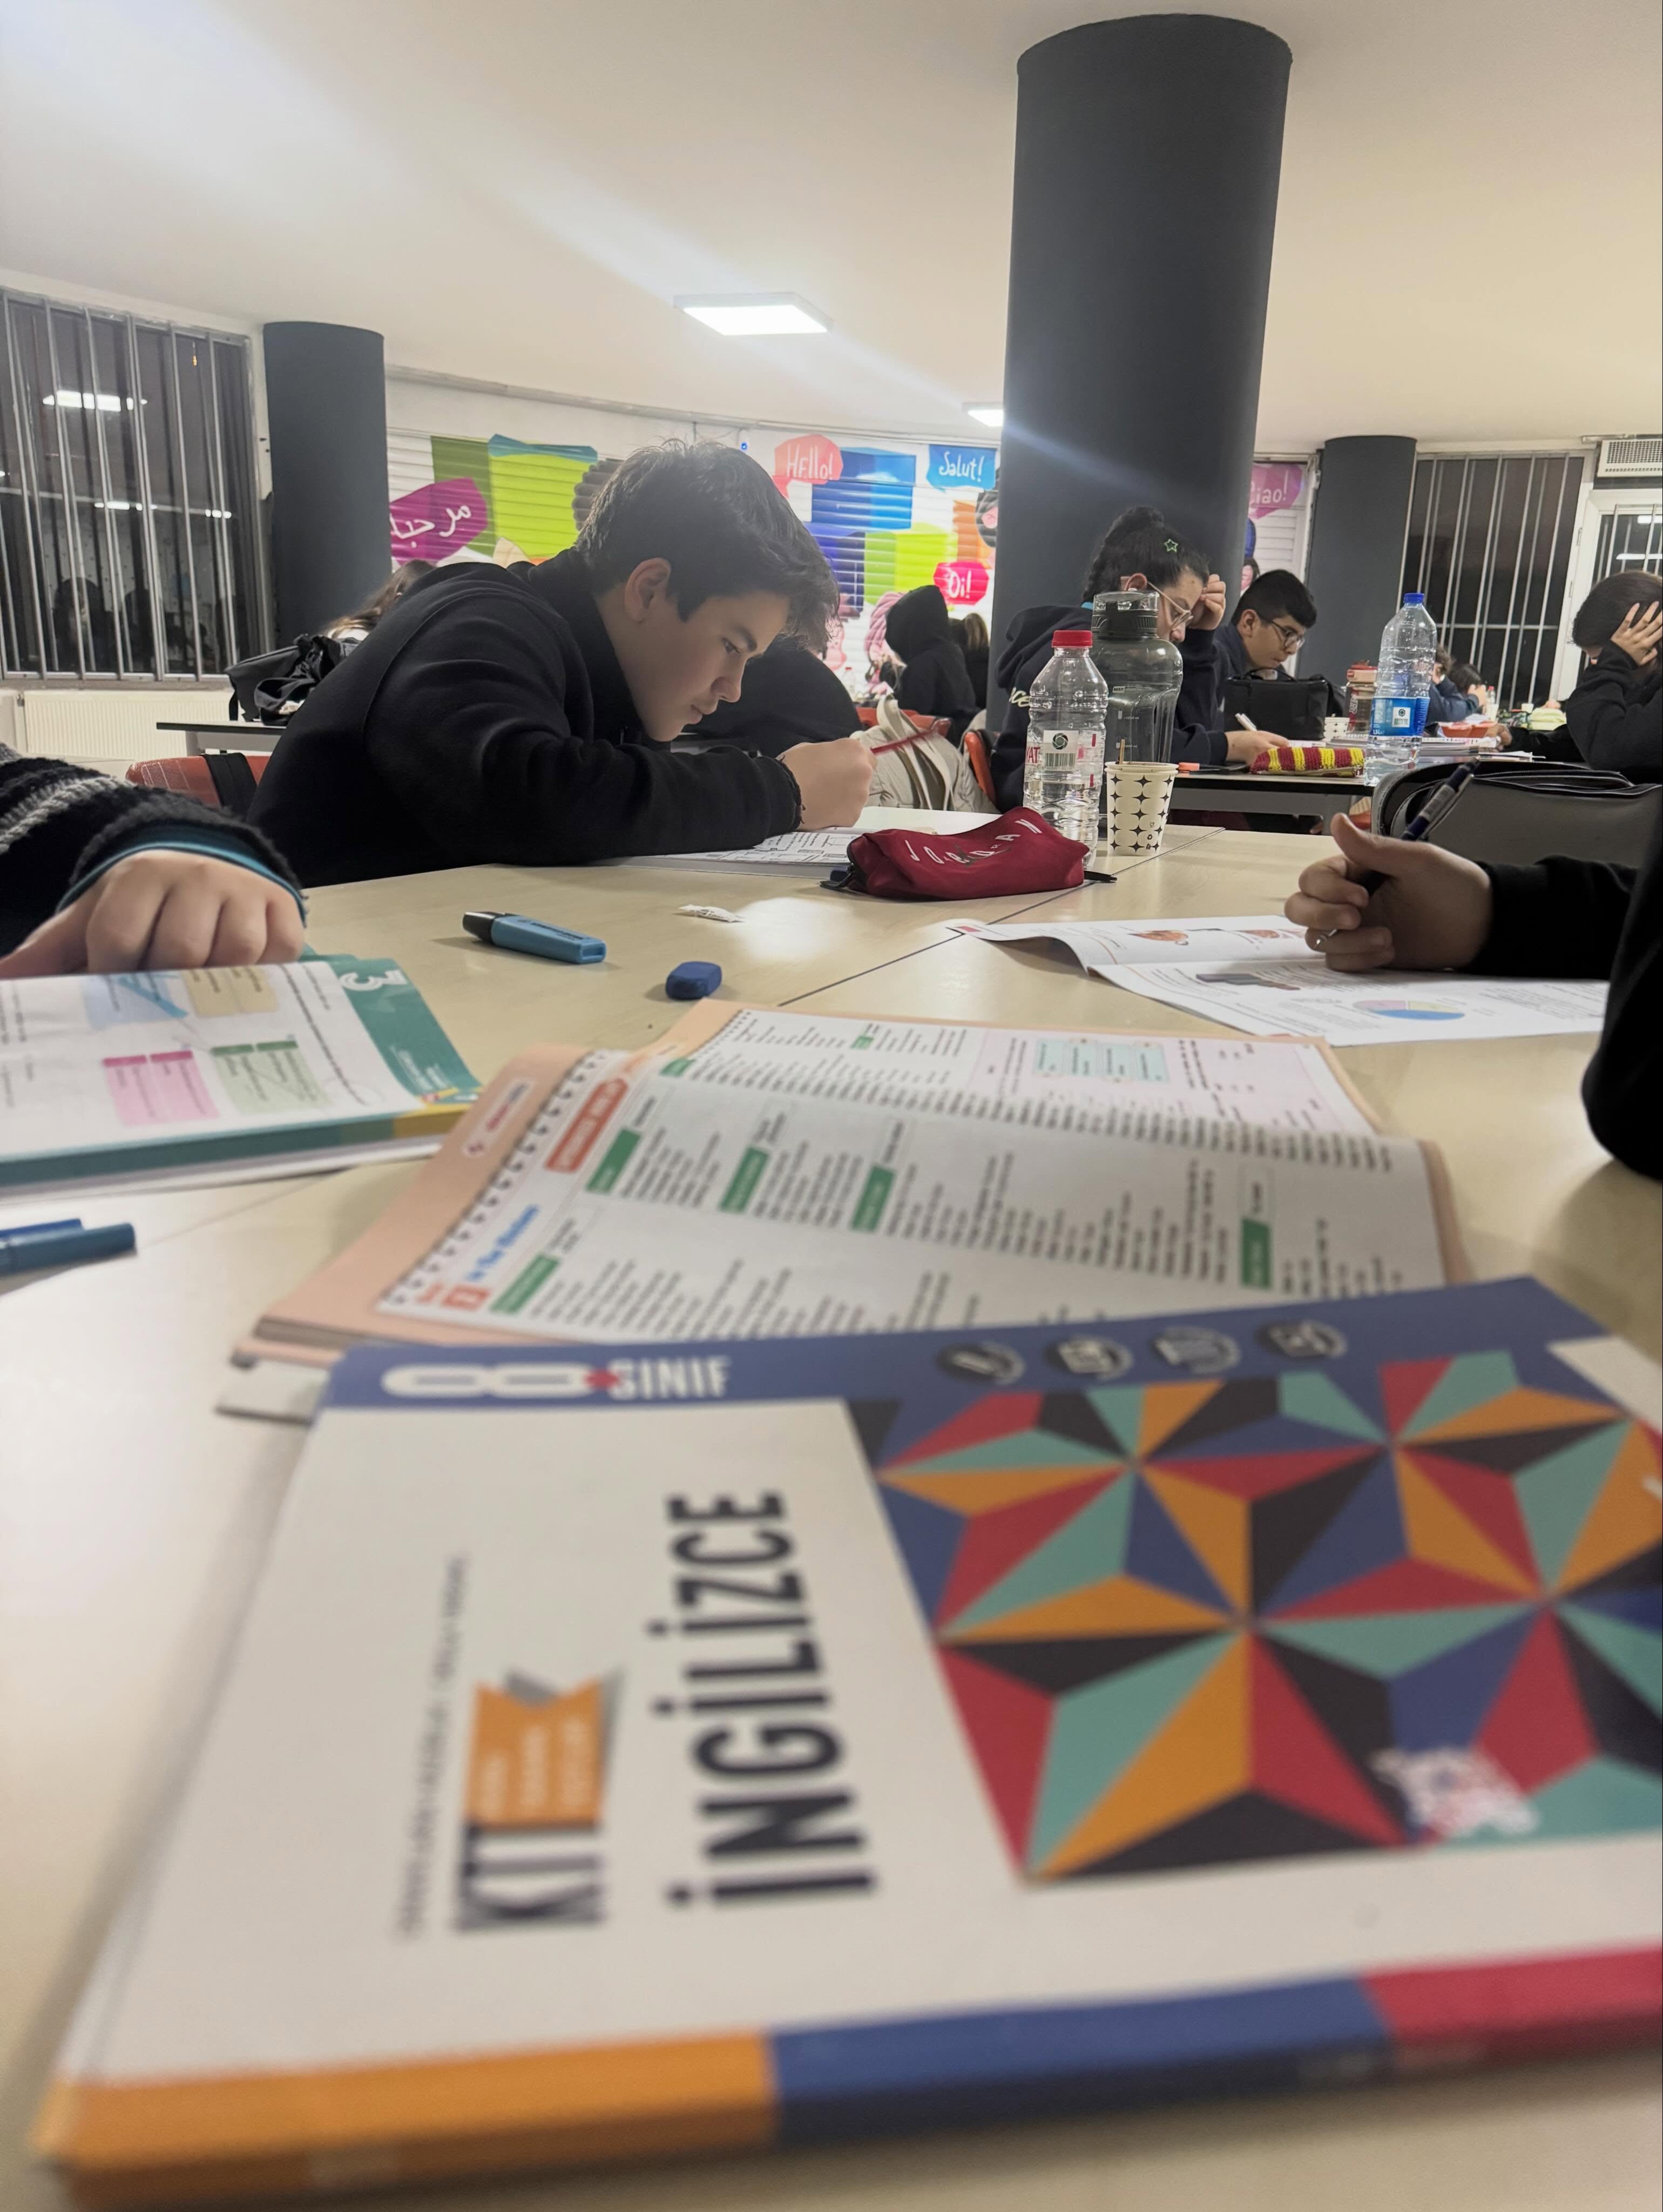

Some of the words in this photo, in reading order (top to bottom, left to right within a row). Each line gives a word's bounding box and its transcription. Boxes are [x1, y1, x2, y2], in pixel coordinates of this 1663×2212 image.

[938, 450, 984, 482] Salut!
[1026, 746, 1040, 764] AT
[904, 819, 1043, 864] JORDAN
[338, 969, 408, 991] 3
[607, 1354, 730, 1401] SINIF
[646, 1491, 876, 1907] İNGİLİZCE
